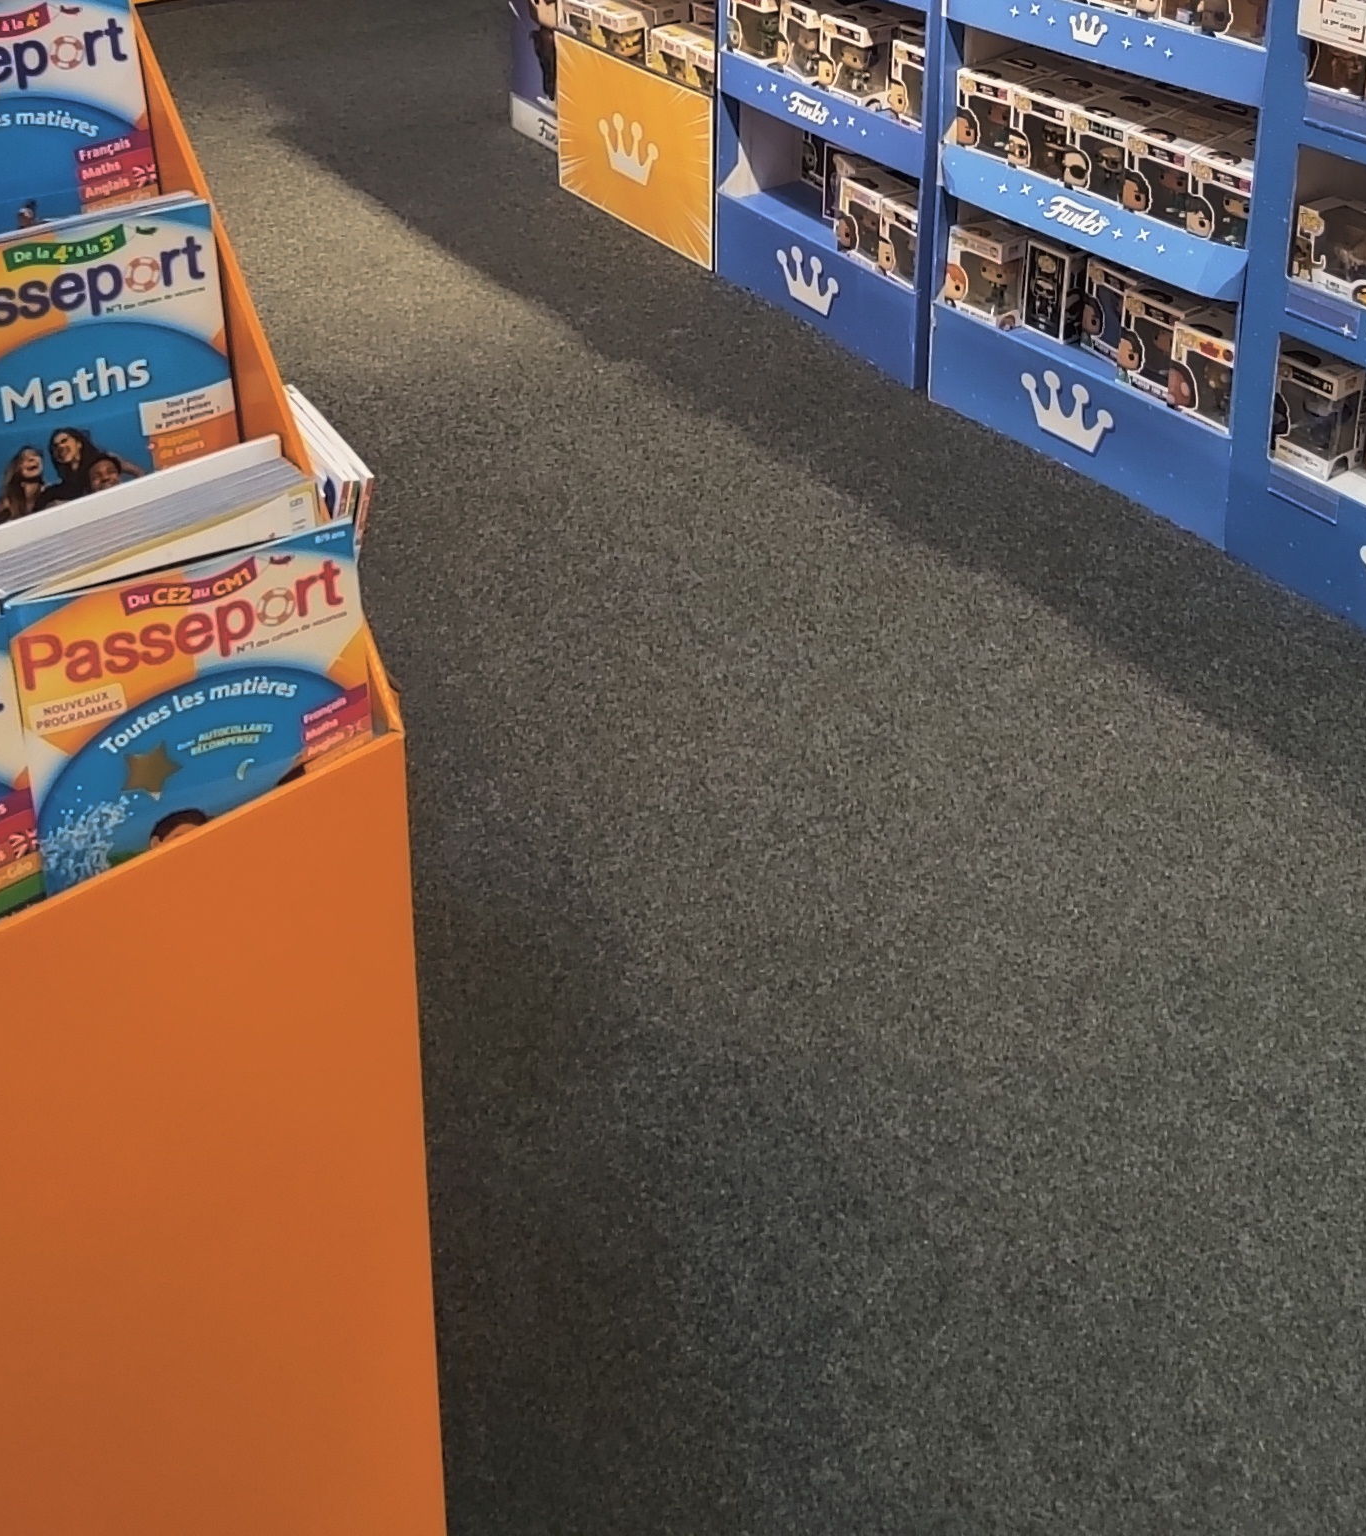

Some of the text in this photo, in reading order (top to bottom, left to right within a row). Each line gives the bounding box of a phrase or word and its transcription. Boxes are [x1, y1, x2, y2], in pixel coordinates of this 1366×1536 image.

[788, 90, 832, 127] Funko
[1043, 195, 1111, 237] Funko
[0, 357, 151, 423] Maths
[16, 560, 344, 692] Passeport
